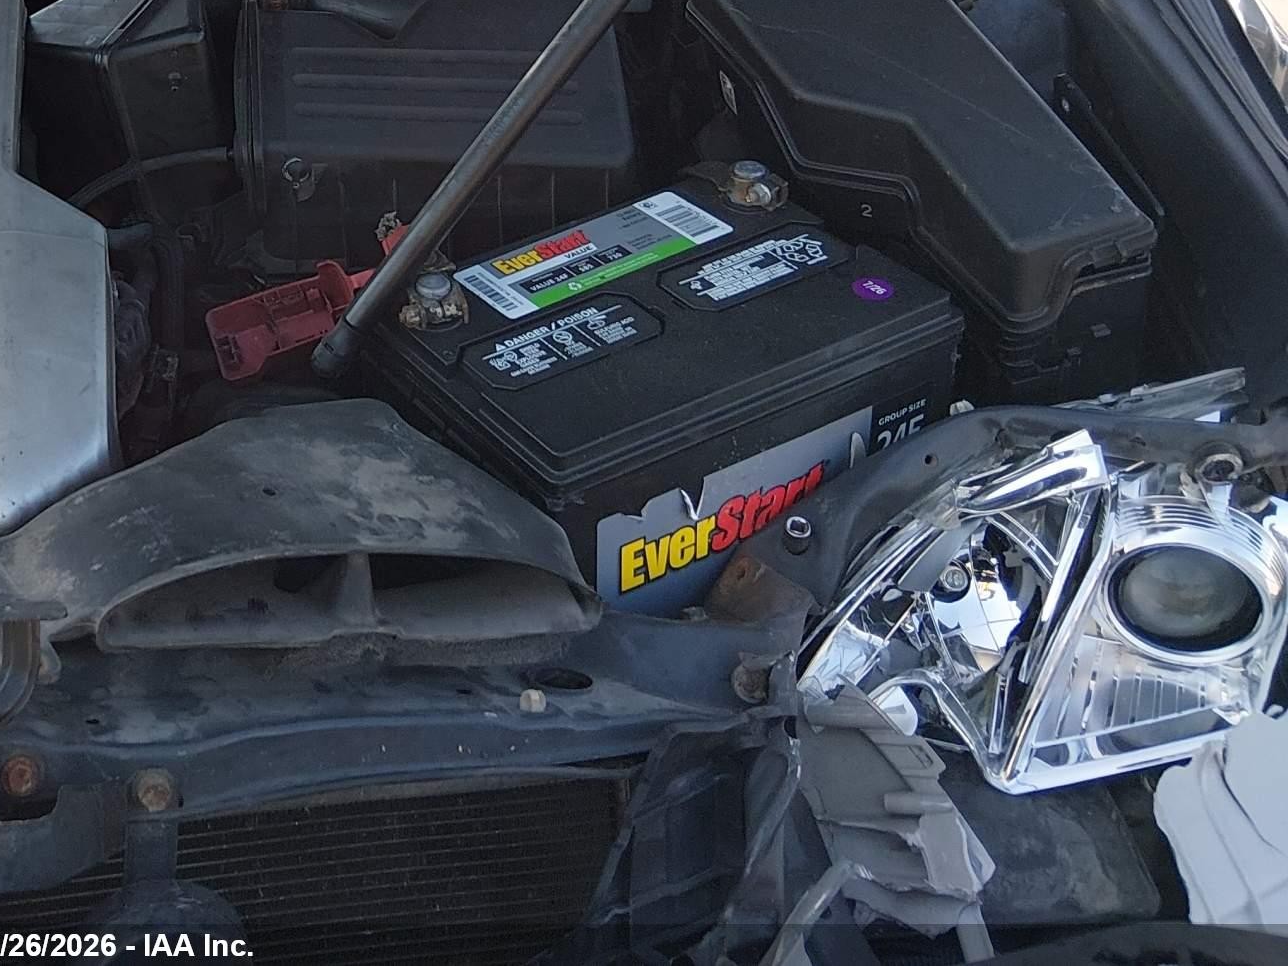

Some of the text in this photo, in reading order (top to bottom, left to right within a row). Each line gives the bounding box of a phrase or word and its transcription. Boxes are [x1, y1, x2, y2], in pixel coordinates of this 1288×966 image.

[860, 203, 873, 218] 2
[490, 229, 592, 276] EverStart
[563, 246, 595, 260] VALUE
[529, 277, 555, 292] VALUE
[862, 280, 888, 295] 7/26
[503, 325, 550, 348] DANGER
[557, 307, 600, 327] POISON
[878, 398, 927, 426] GROUP SIZE
[618, 459, 826, 594] EverStart
